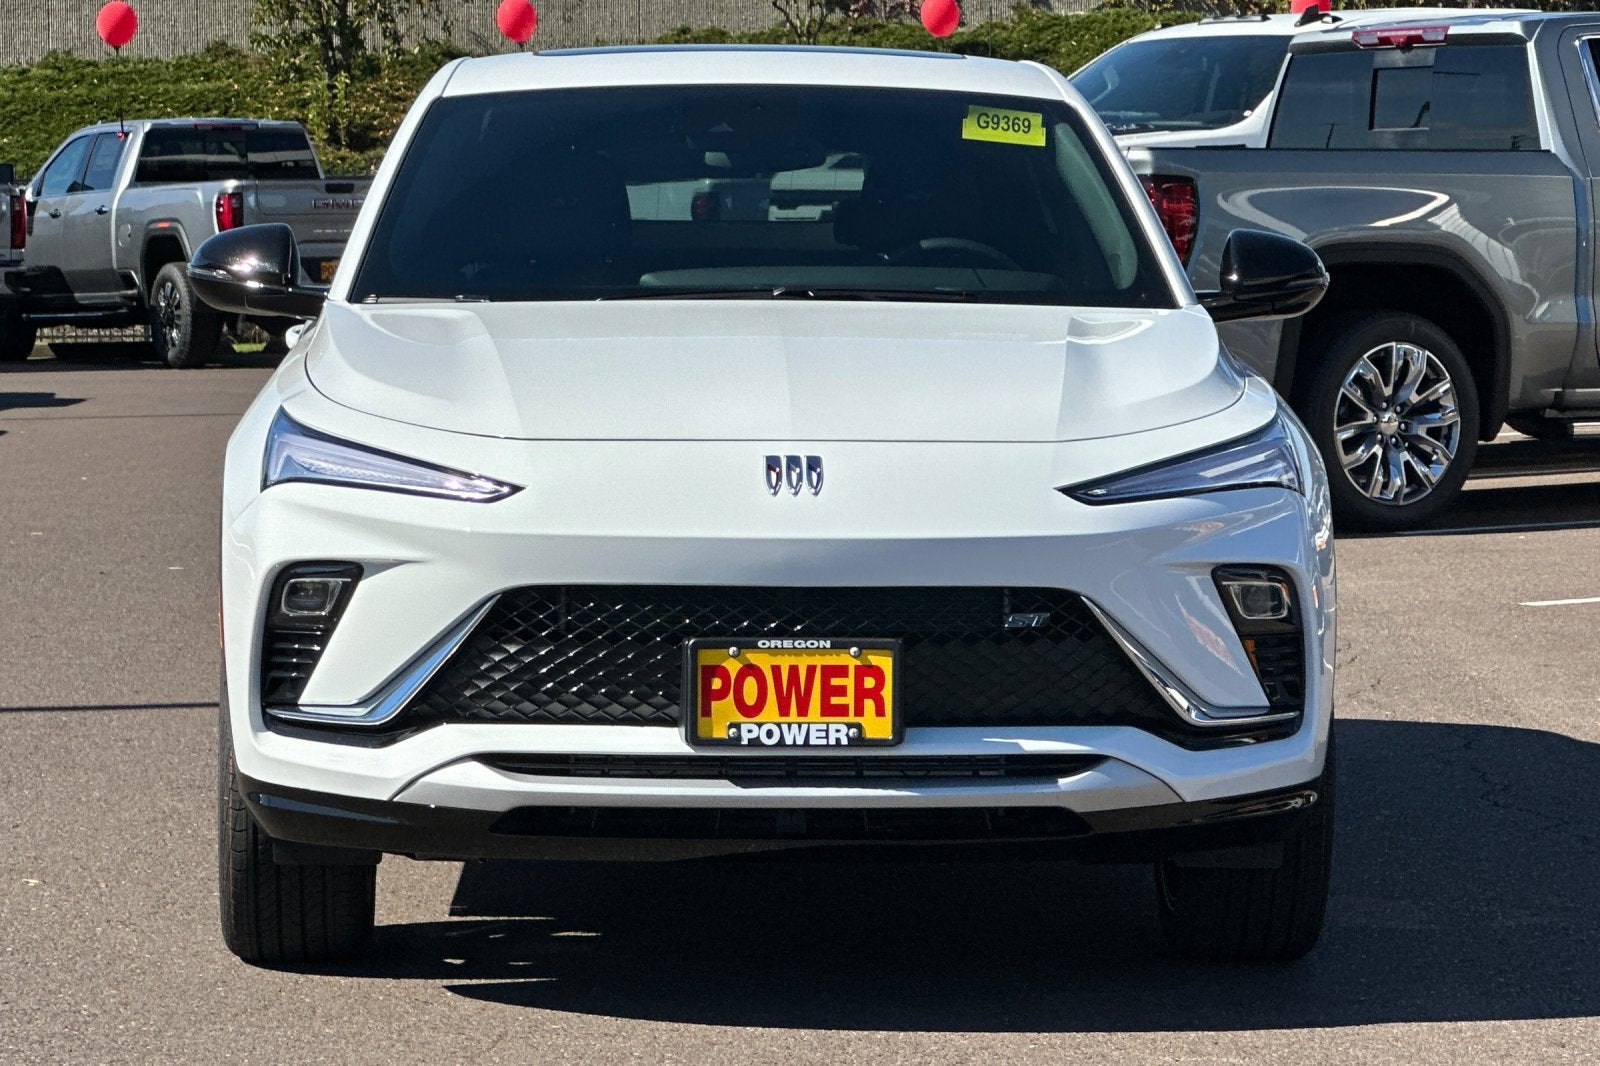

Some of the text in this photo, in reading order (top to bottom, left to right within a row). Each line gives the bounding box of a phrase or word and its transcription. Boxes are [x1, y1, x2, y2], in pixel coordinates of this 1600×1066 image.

[976, 112, 1031, 134] G9369
[757, 639, 831, 649] OREGON
[700, 663, 886, 719] POWER
[740, 723, 848, 745] POWER
